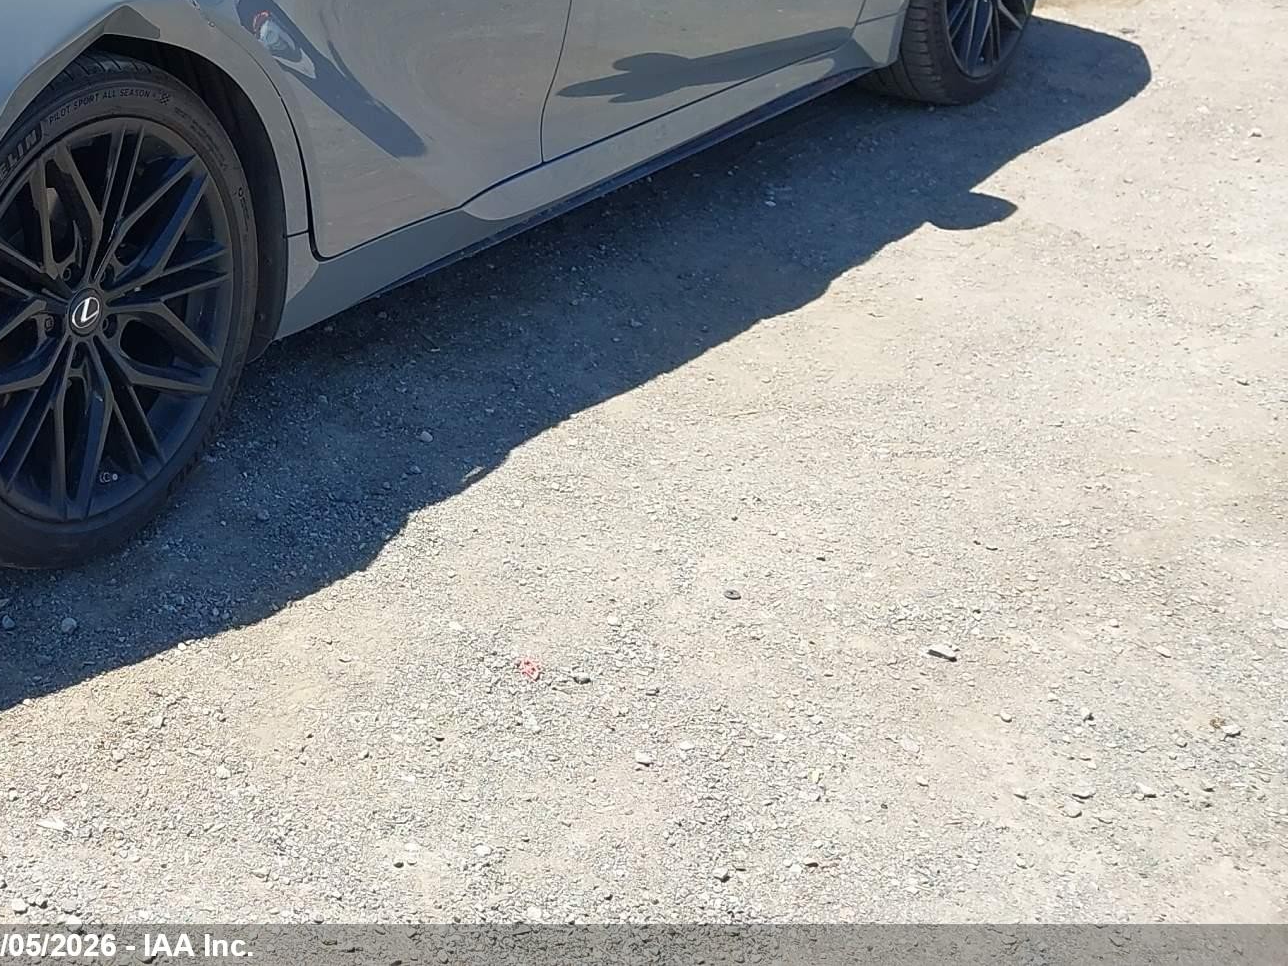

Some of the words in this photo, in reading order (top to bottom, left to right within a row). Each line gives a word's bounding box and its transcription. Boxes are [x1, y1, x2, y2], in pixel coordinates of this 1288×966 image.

[49, 105, 71, 124] PILOT
[73, 93, 100, 111] SPORT
[103, 89, 116, 99] ALL
[119, 88, 151, 99] SEASON
